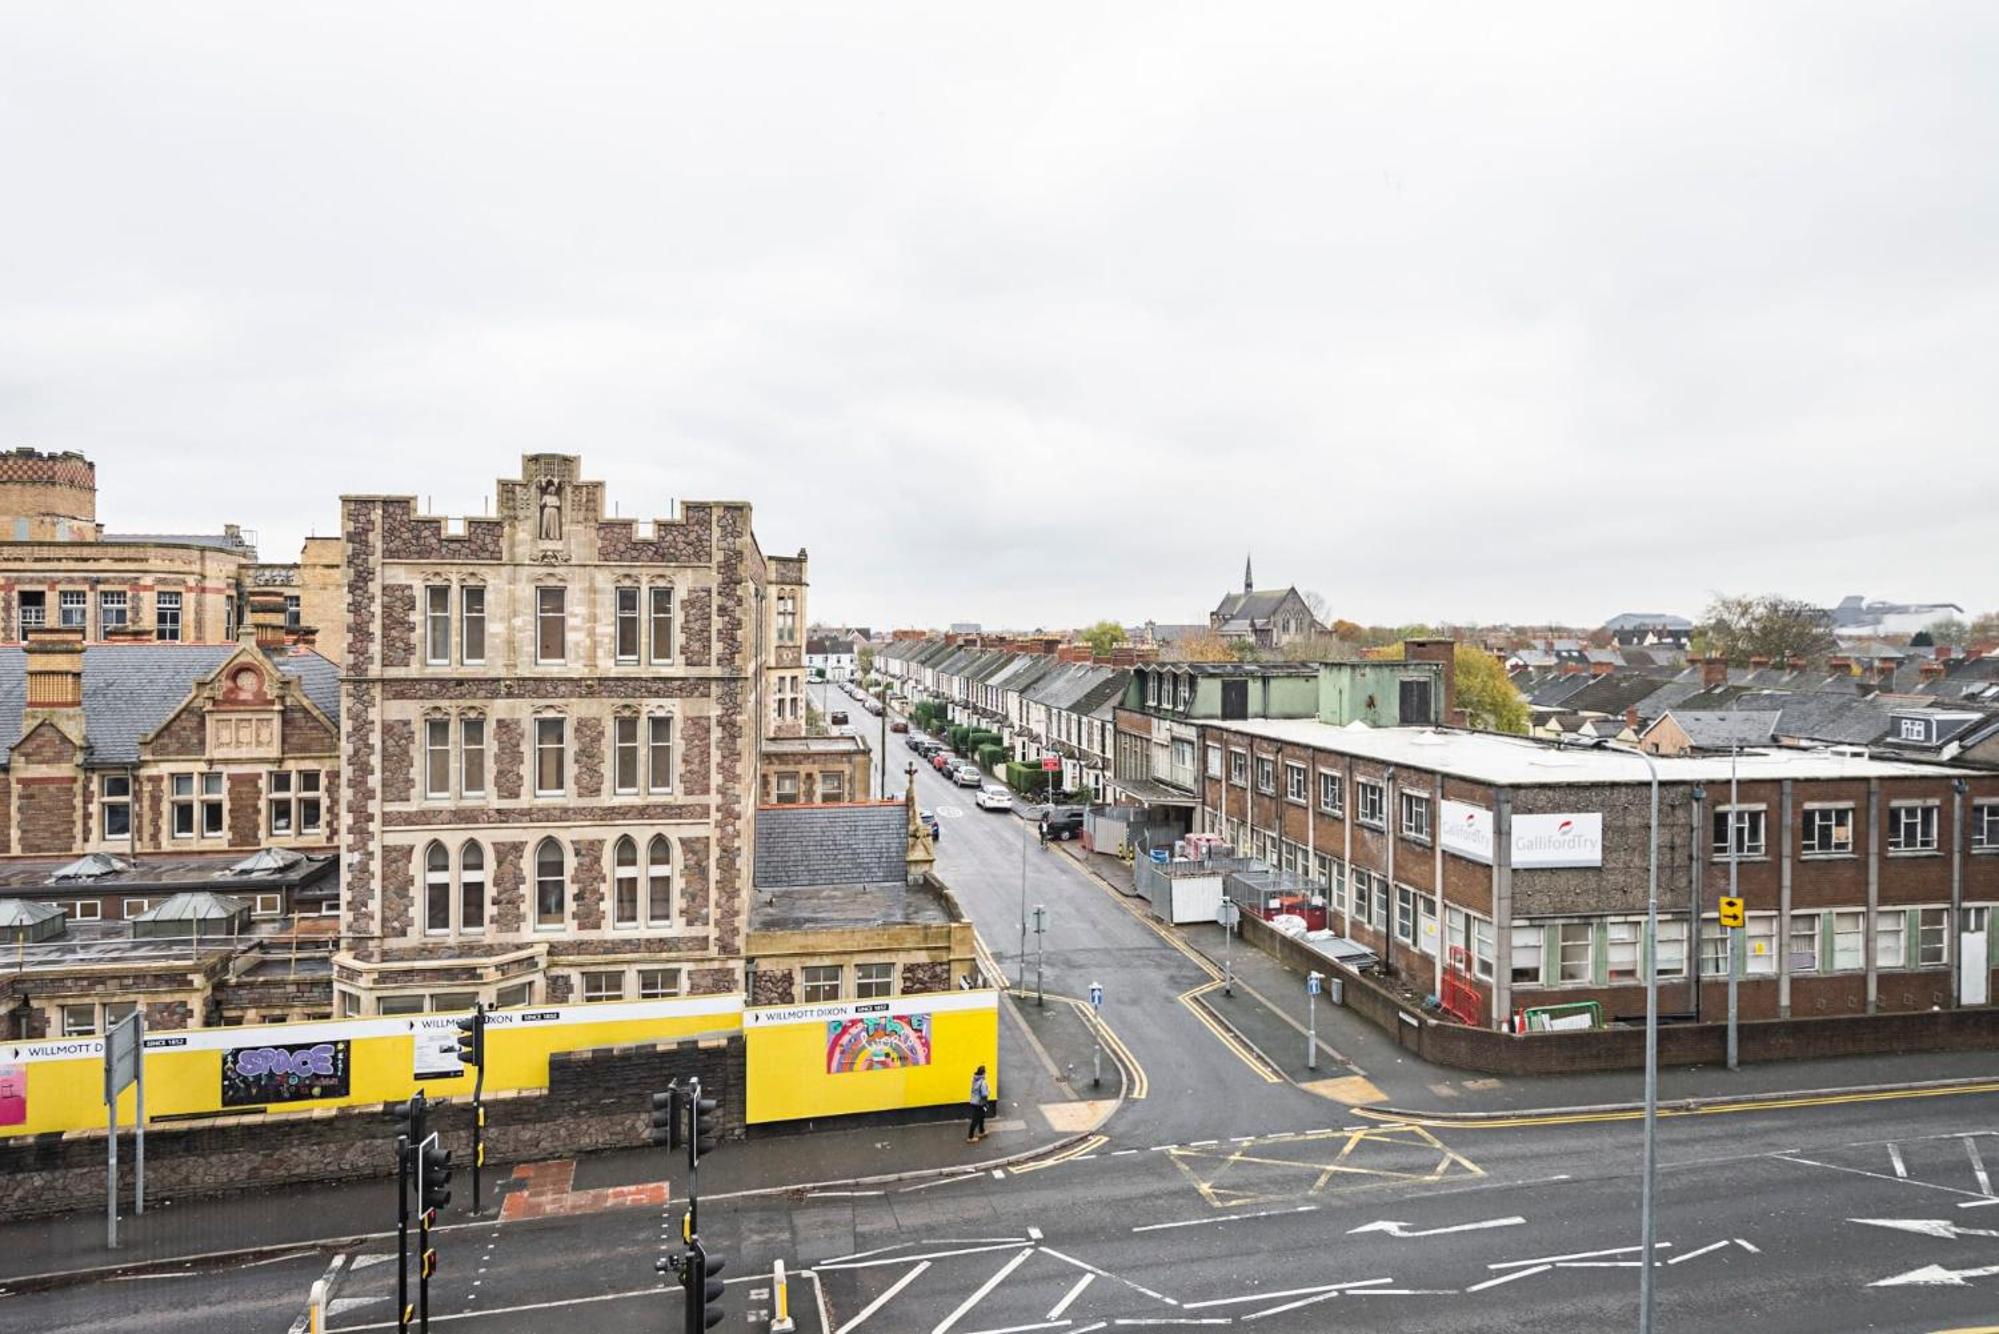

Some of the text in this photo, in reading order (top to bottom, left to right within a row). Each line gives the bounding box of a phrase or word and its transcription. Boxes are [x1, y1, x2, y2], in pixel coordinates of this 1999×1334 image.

[765, 1006, 848, 1021] WILLMOTT DIXON
[28, 1043, 91, 1057] WILLMOTT
[236, 1044, 335, 1077] SPACE
